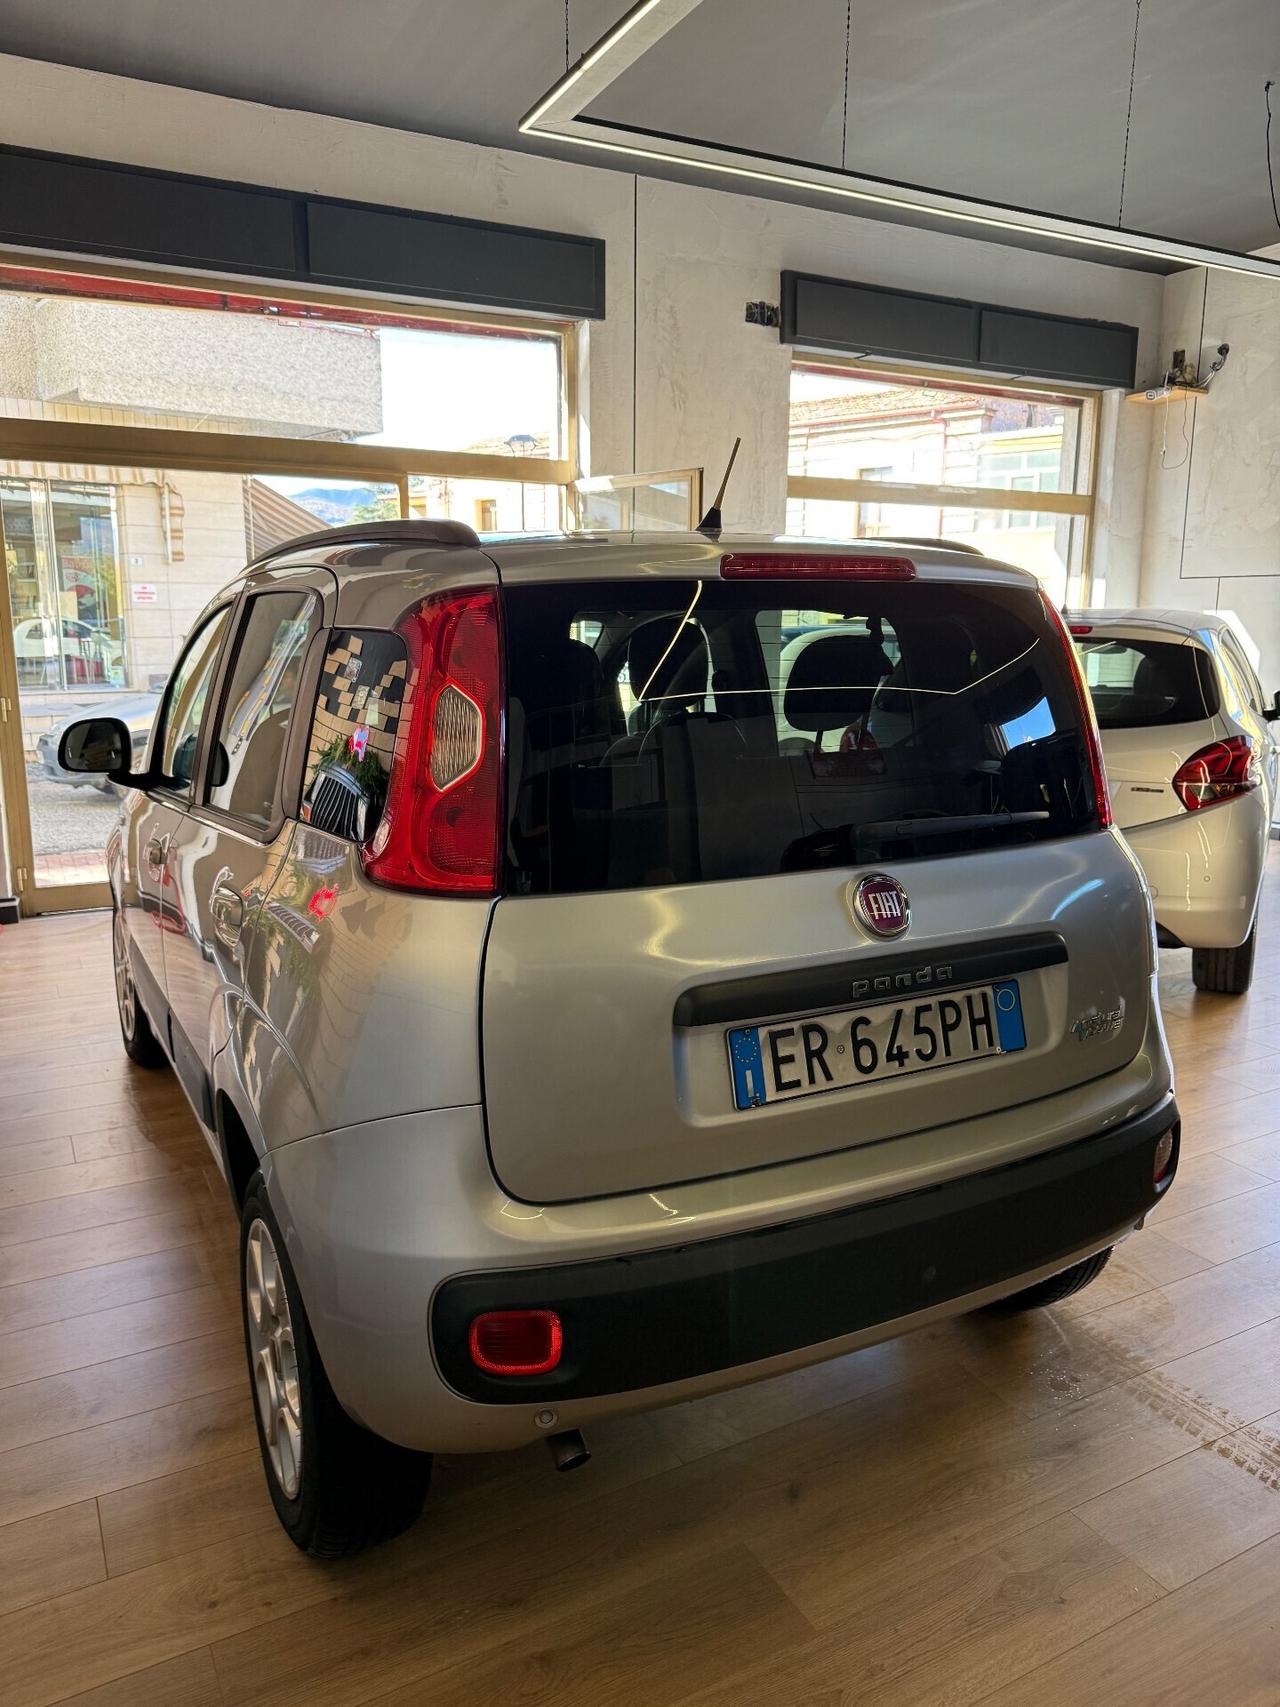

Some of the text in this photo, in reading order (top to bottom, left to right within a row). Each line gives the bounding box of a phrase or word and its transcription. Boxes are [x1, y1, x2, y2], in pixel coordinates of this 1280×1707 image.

[868, 891, 901, 920] FIAT
[852, 966, 952, 998] panda
[768, 991, 995, 1092] ER 645PH
